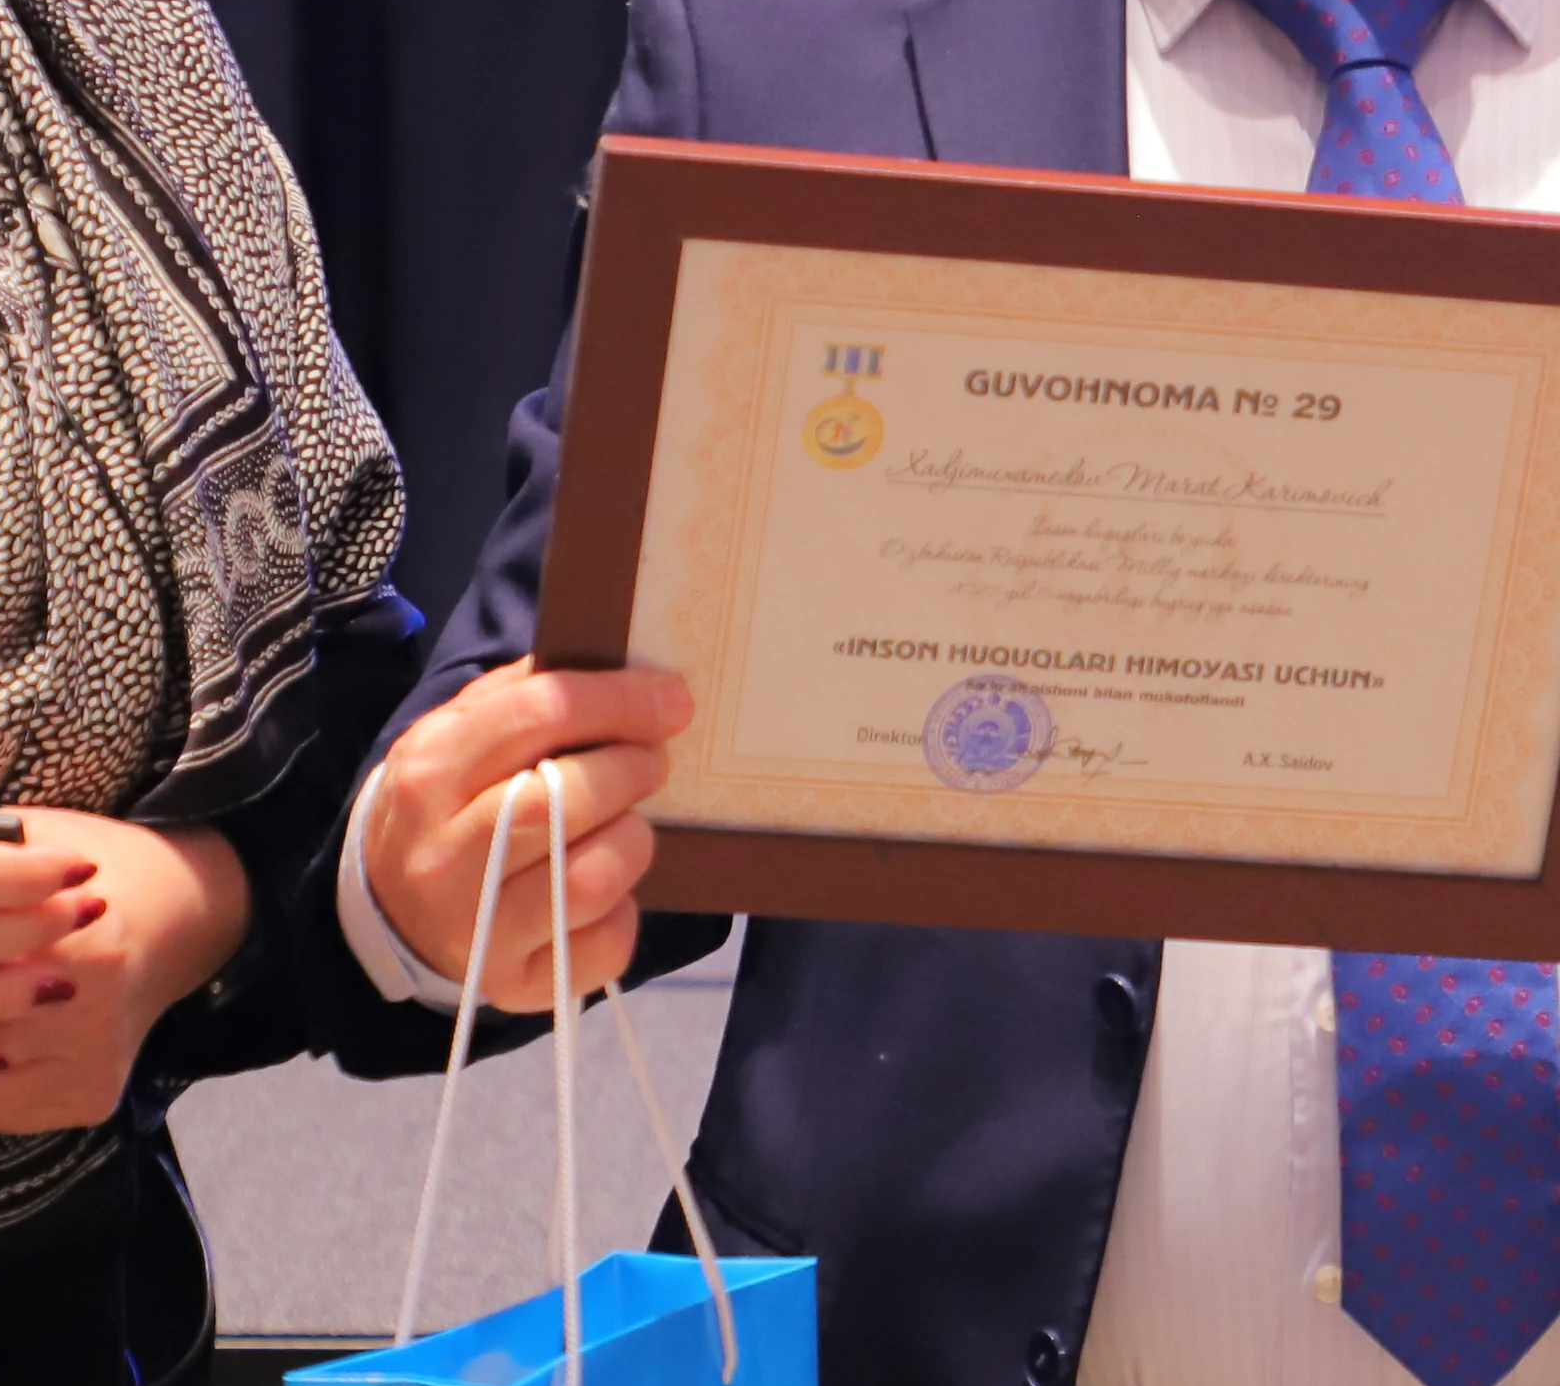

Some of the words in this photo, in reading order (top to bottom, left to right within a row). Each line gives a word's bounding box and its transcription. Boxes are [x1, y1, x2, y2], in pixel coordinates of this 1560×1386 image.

[963, 368, 1220, 413] GUVOHNOMA
[1291, 391, 1342, 422] 29
[947, 642, 1116, 674] HUQUQLARI
[1125, 654, 1265, 683] HIMOYASI
